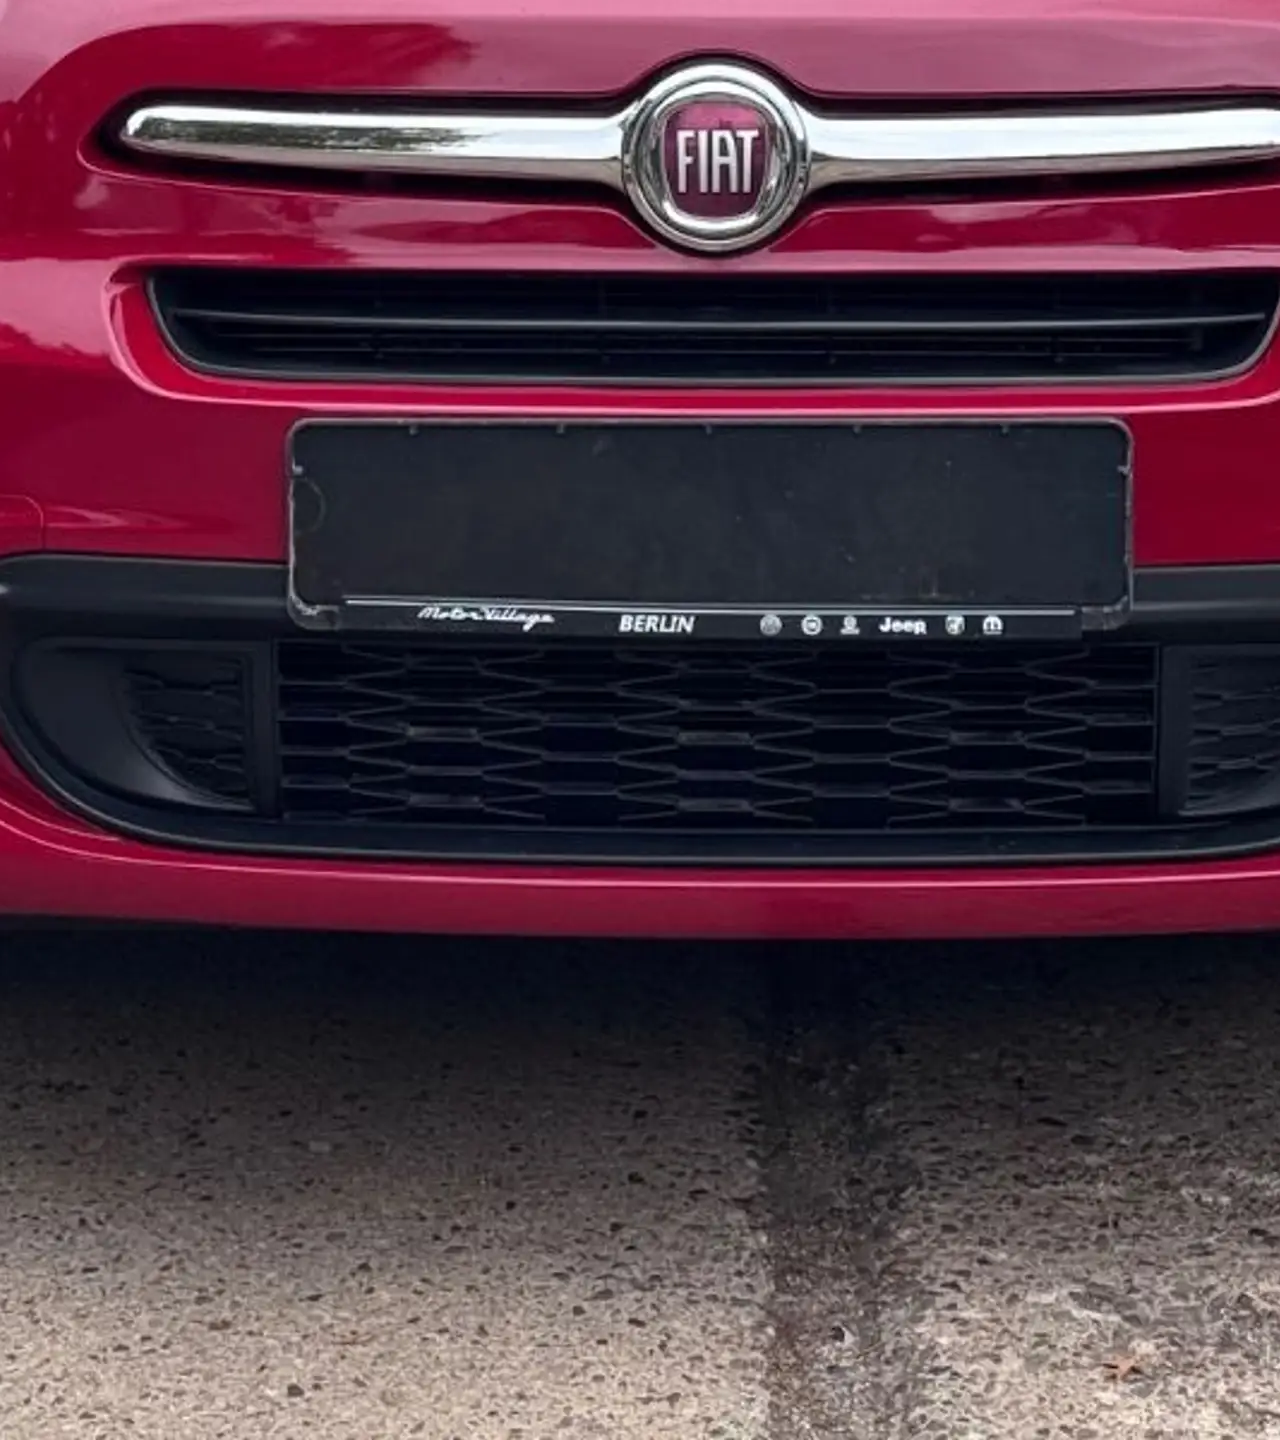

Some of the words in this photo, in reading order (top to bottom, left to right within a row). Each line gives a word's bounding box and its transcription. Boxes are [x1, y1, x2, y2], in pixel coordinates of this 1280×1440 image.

[676, 129, 759, 194] FIAT
[619, 614, 695, 633] BERLIN
[879, 616, 927, 635] Jeep
